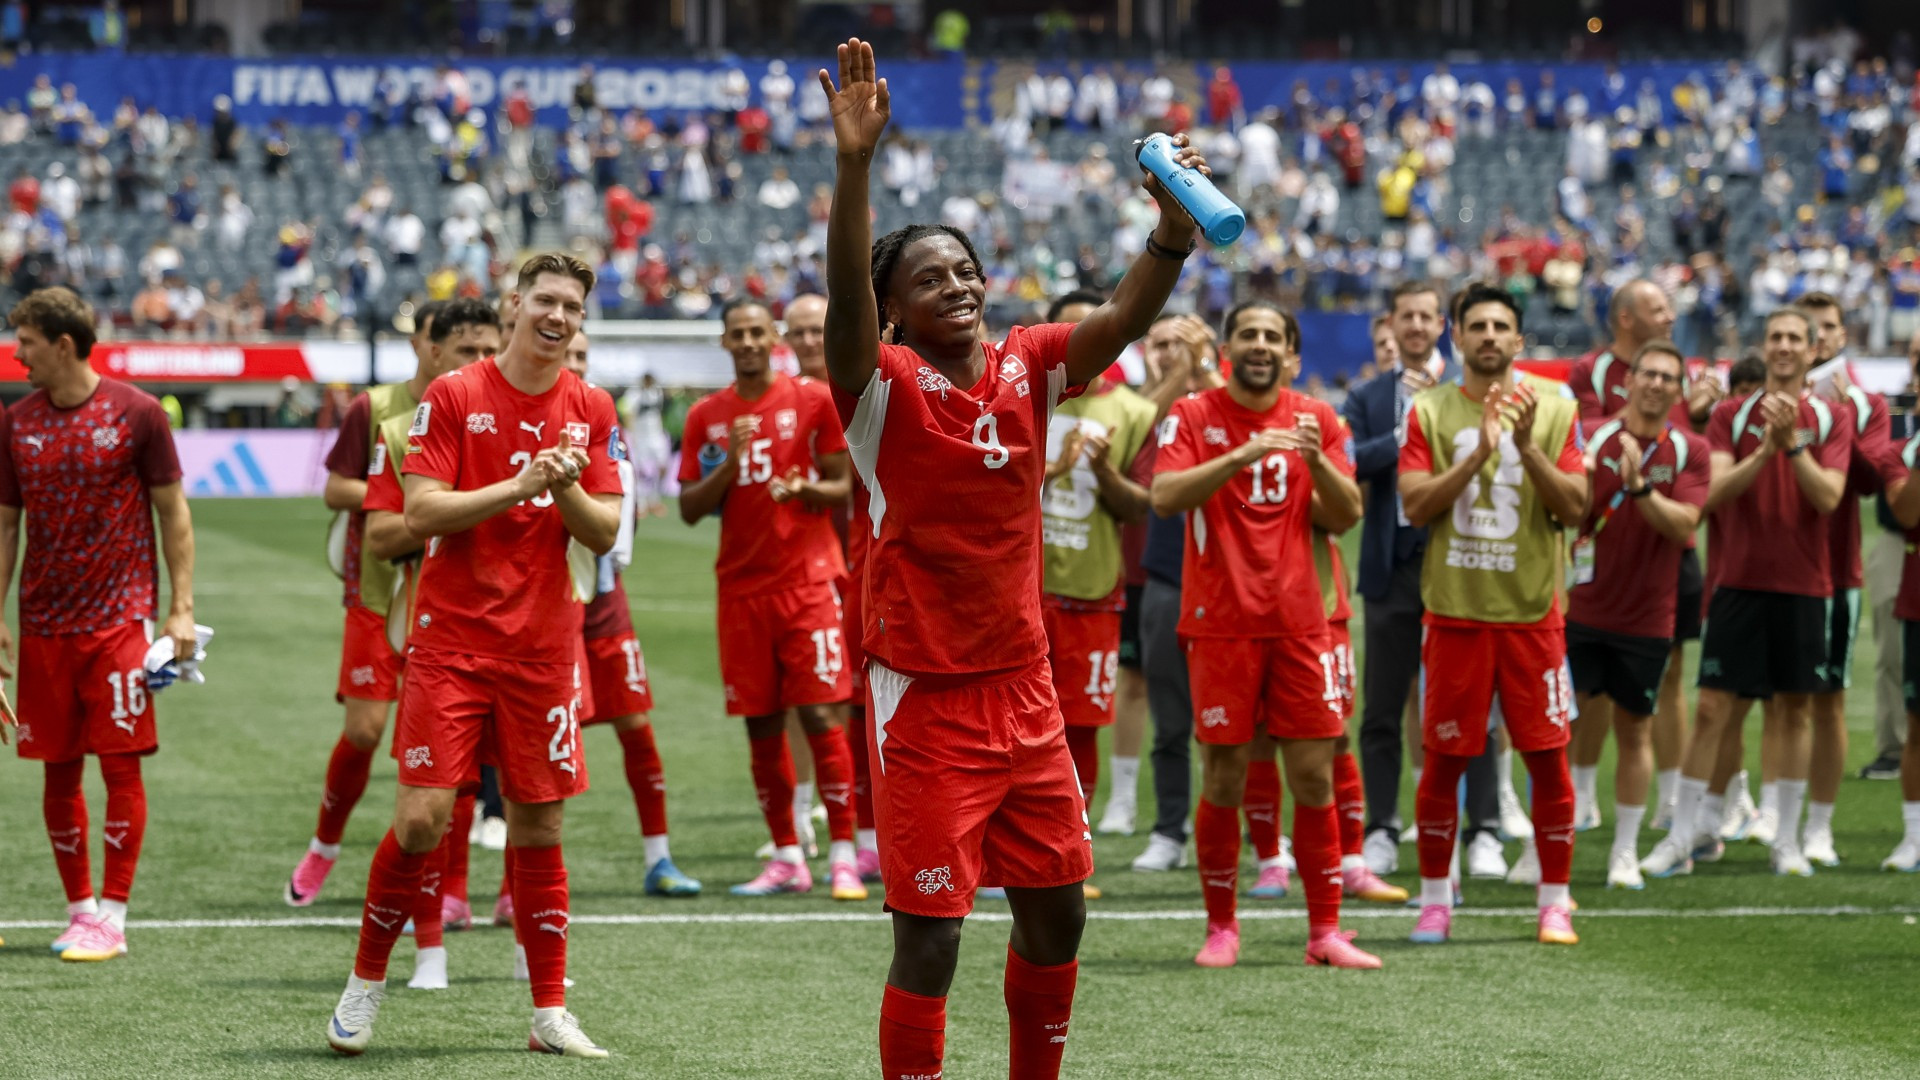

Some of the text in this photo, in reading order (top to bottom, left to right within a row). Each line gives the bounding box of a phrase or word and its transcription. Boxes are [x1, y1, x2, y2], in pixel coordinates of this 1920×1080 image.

[233, 65, 331, 106] FIFA
[332, 65, 496, 107] WOD
[736, 438, 773, 486] 15
[972, 412, 1010, 470] 9
[1248, 454, 1289, 504] 13
[1446, 549, 1516, 573] 2026
[811, 627, 843, 675] 15
[1084, 650, 1119, 695] 19
[107, 668, 147, 719] 16
